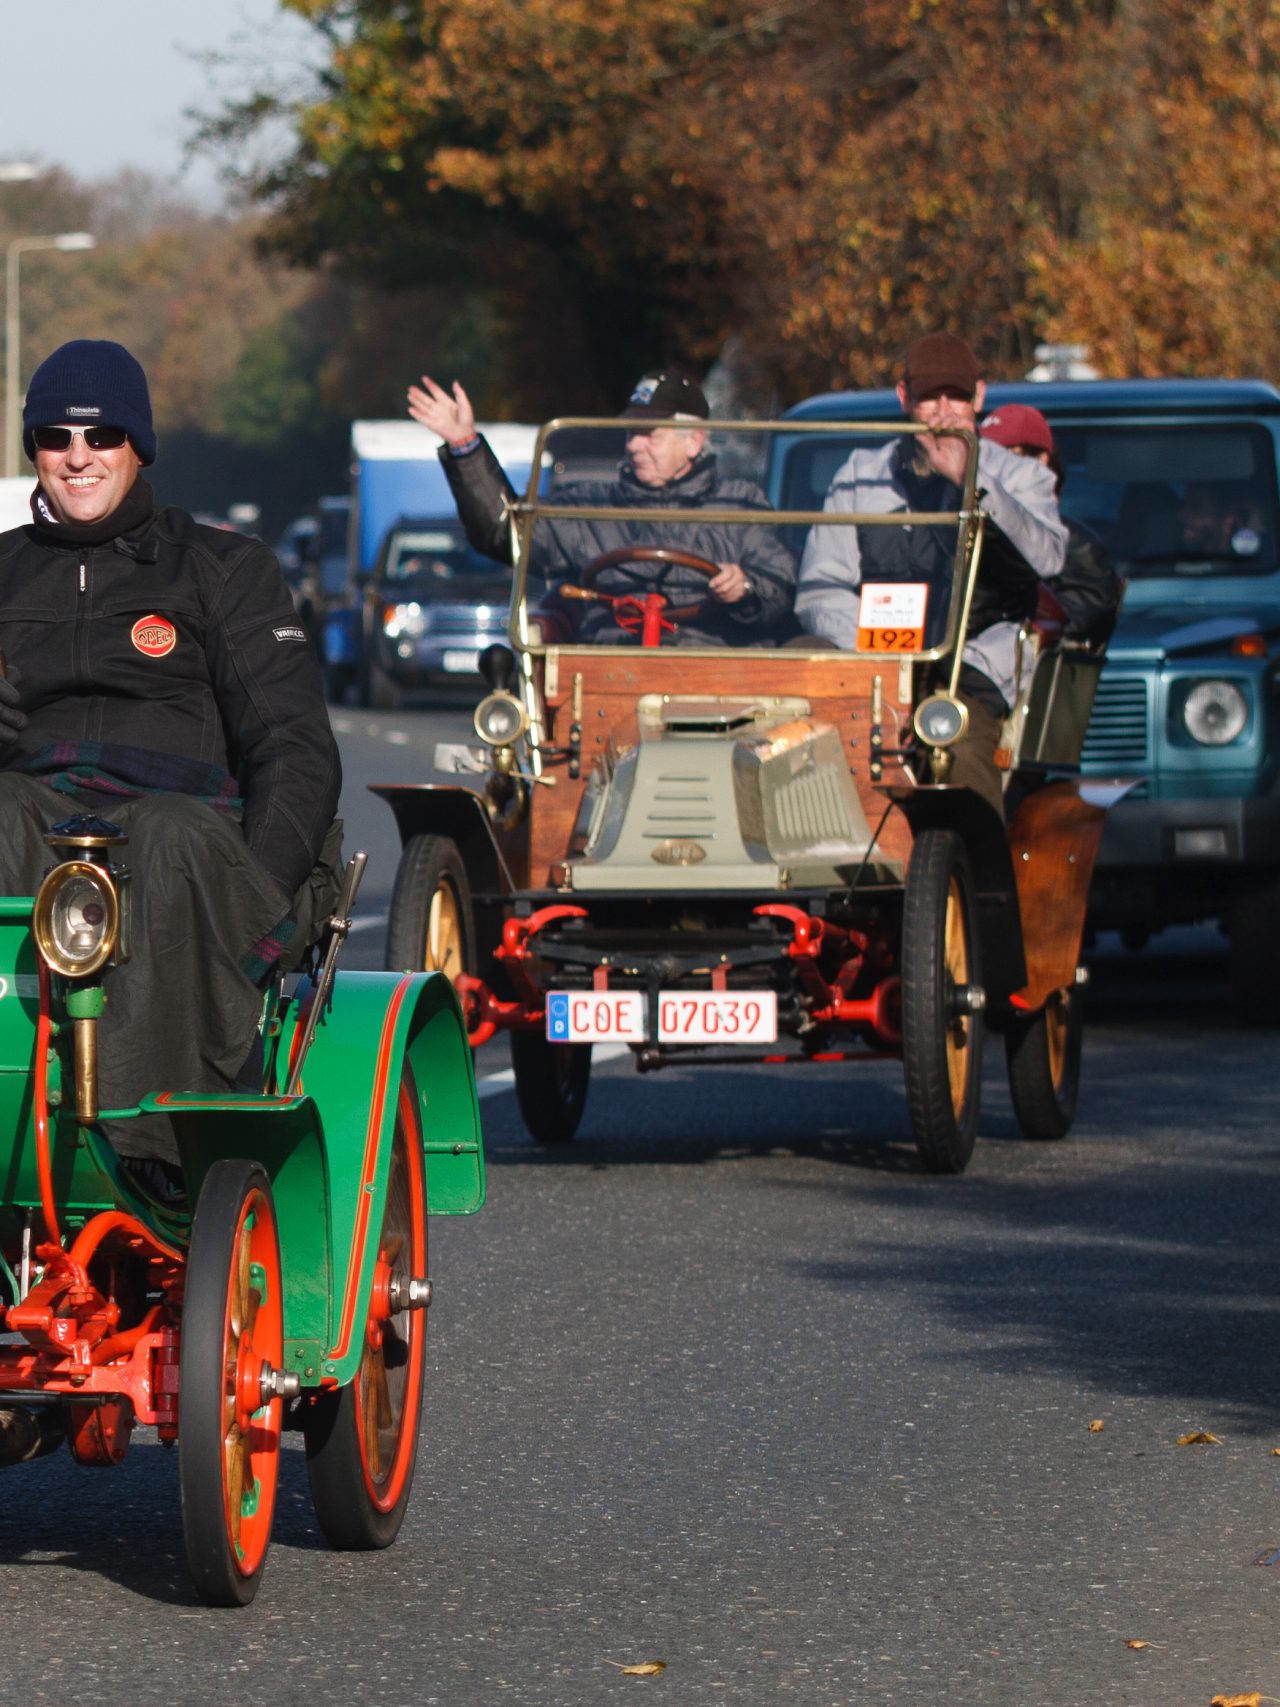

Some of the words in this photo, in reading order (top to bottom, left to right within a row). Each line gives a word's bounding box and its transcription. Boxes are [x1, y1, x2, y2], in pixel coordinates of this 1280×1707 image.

[138, 628, 172, 645] OPEL
[865, 629, 916, 650] 192
[573, 1000, 633, 1034] COE
[661, 1001, 761, 1034] 07039
